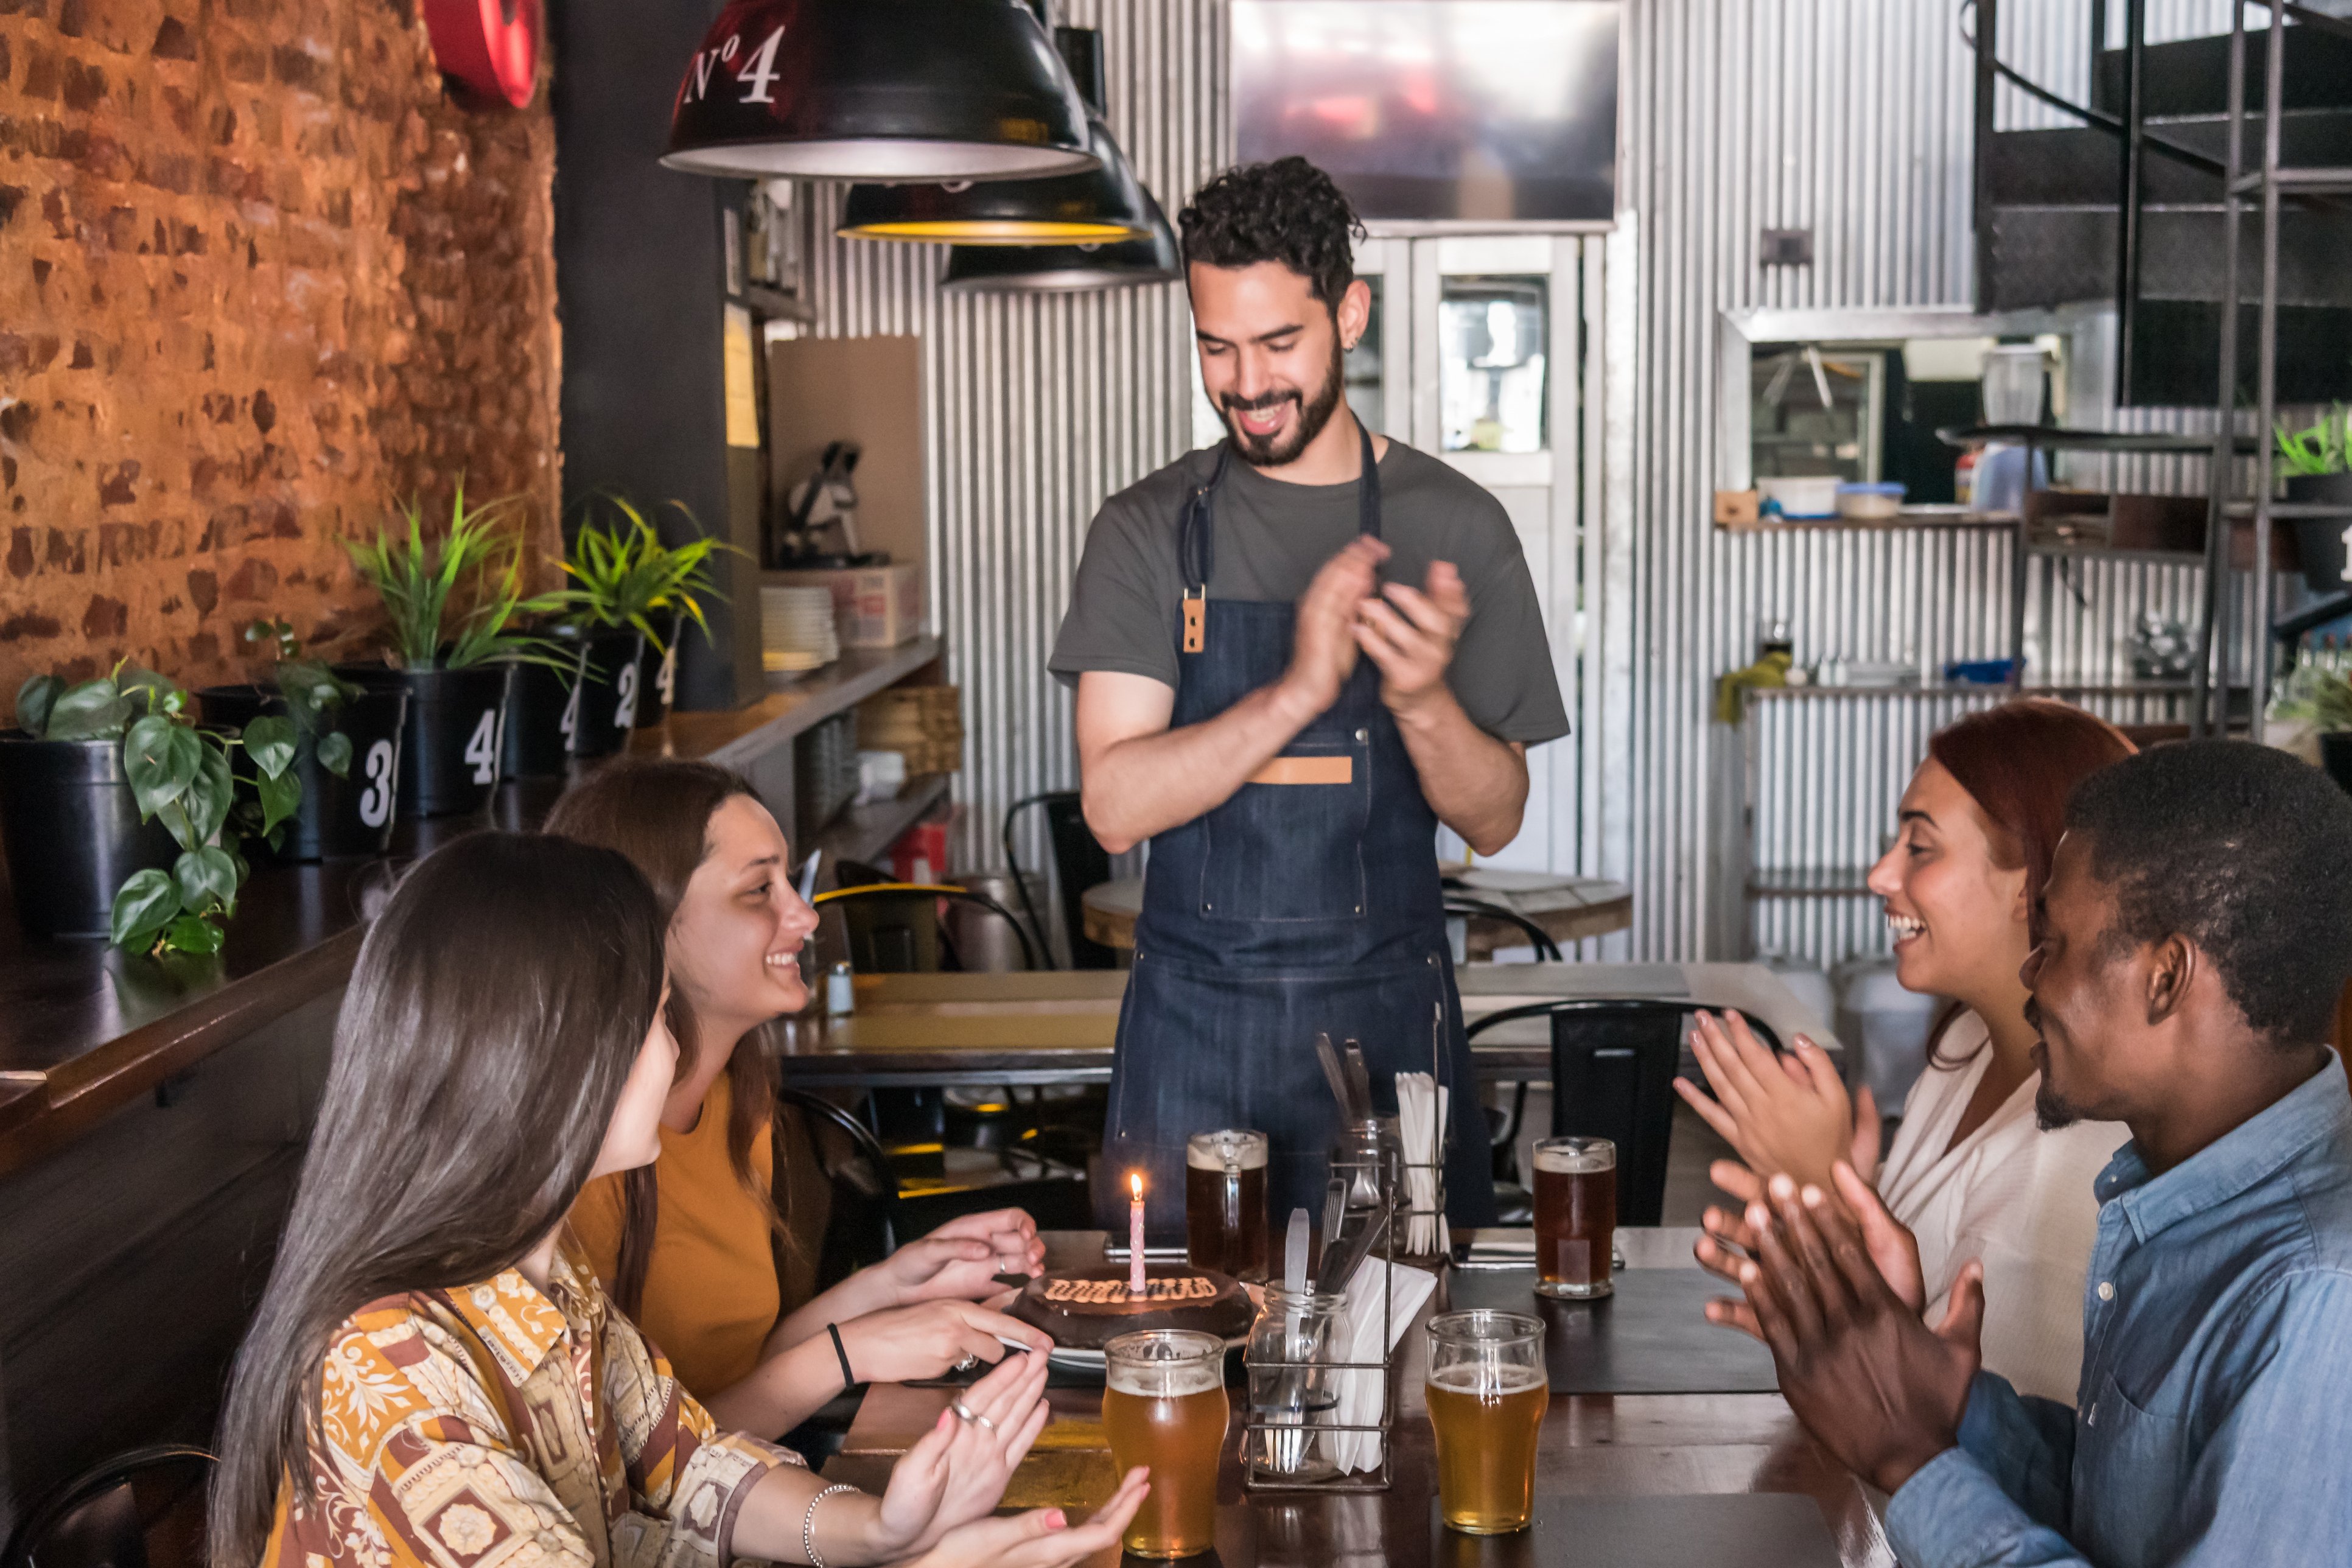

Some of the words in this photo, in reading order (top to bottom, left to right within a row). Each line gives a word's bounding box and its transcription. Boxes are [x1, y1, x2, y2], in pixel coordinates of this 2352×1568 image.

[614, 662, 638, 728] 2
[656, 647, 676, 705] 4
[464, 709, 496, 785] 4
[560, 683, 581, 752] 4
[360, 739, 393, 828] 3
